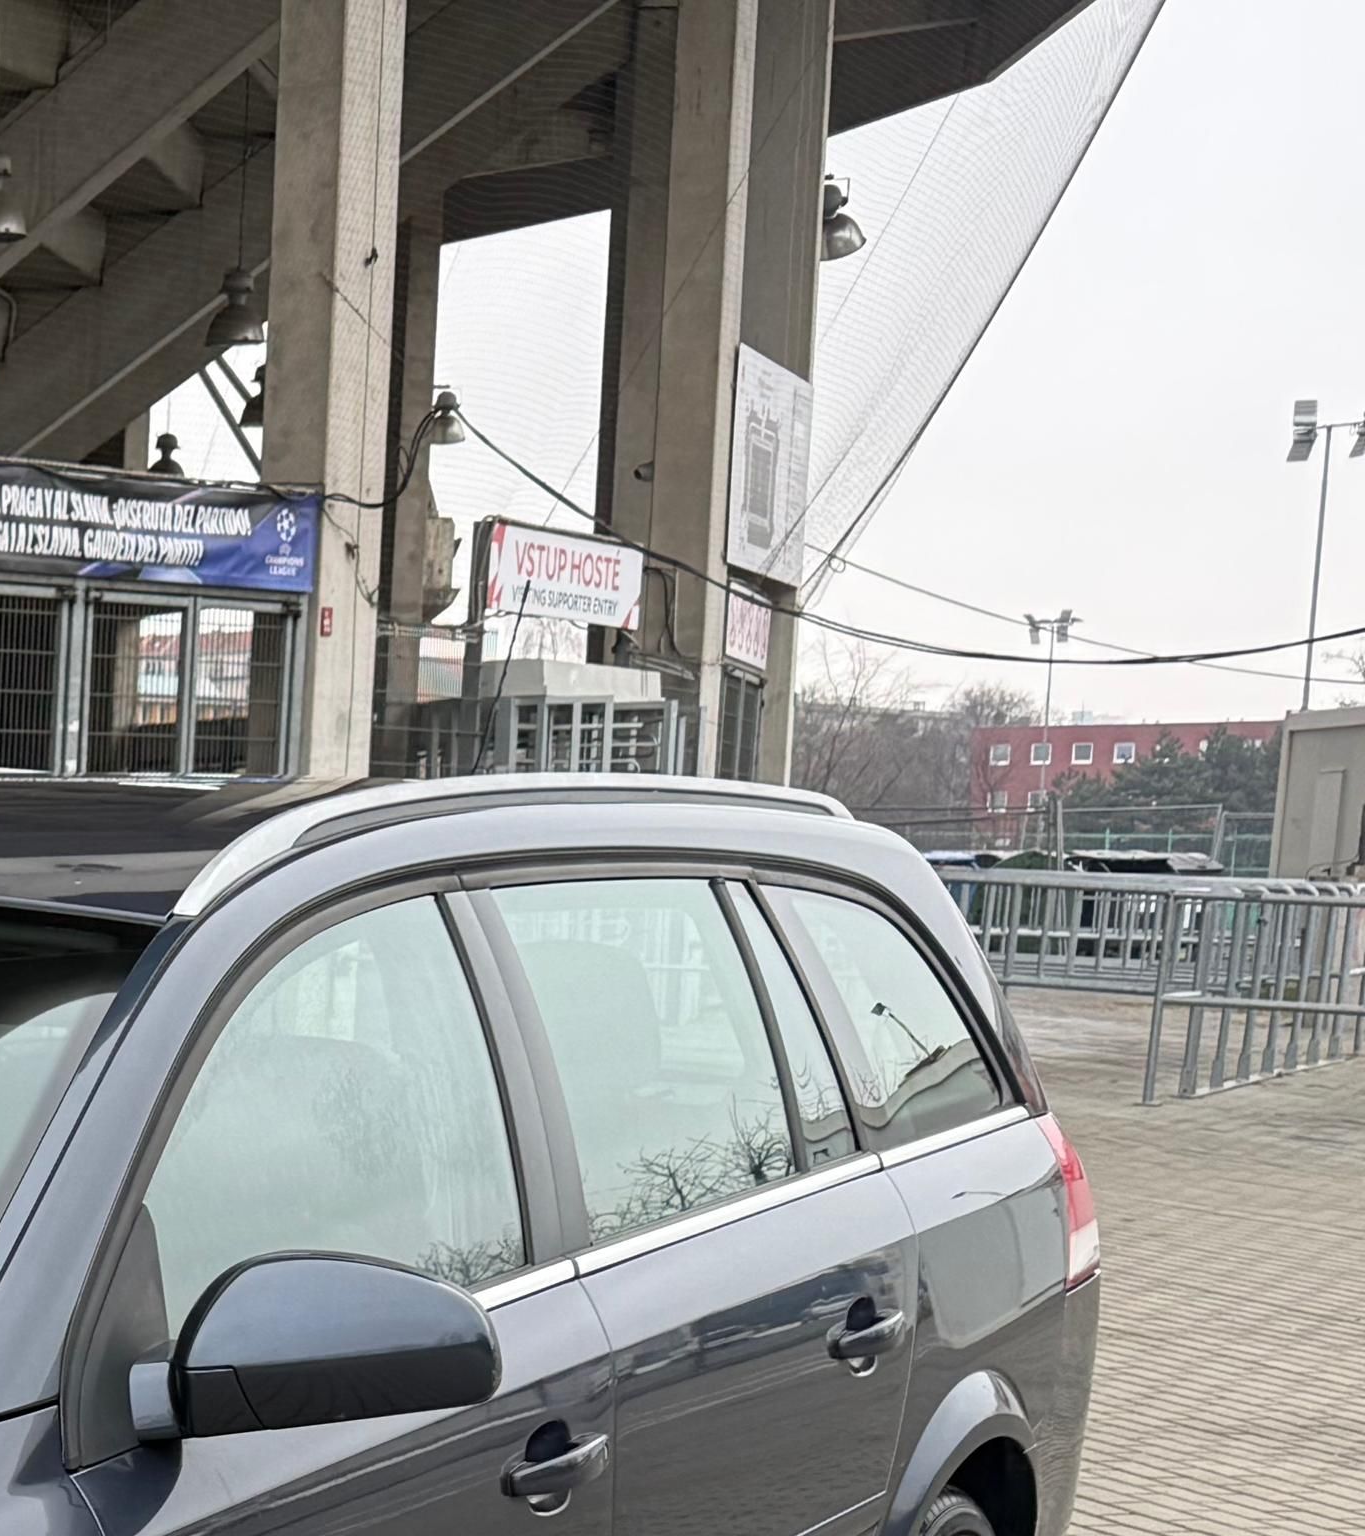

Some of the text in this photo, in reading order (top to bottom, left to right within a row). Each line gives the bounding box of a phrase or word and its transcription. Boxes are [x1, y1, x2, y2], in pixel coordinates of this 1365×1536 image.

[1, 484, 44, 518] PRAGA
[44, 488, 54, 519] Y
[53, 490, 69, 520] AL
[173, 504, 195, 534] DEL
[196, 506, 253, 537] PARTIDO!
[84, 529, 139, 562] GAUDEIX
[139, 534, 158, 564] DEL
[515, 540, 621, 591] VSTUP HOSTÉ
[548, 590, 591, 613] SUPPORTER
[593, 597, 618, 616] ENTRY
